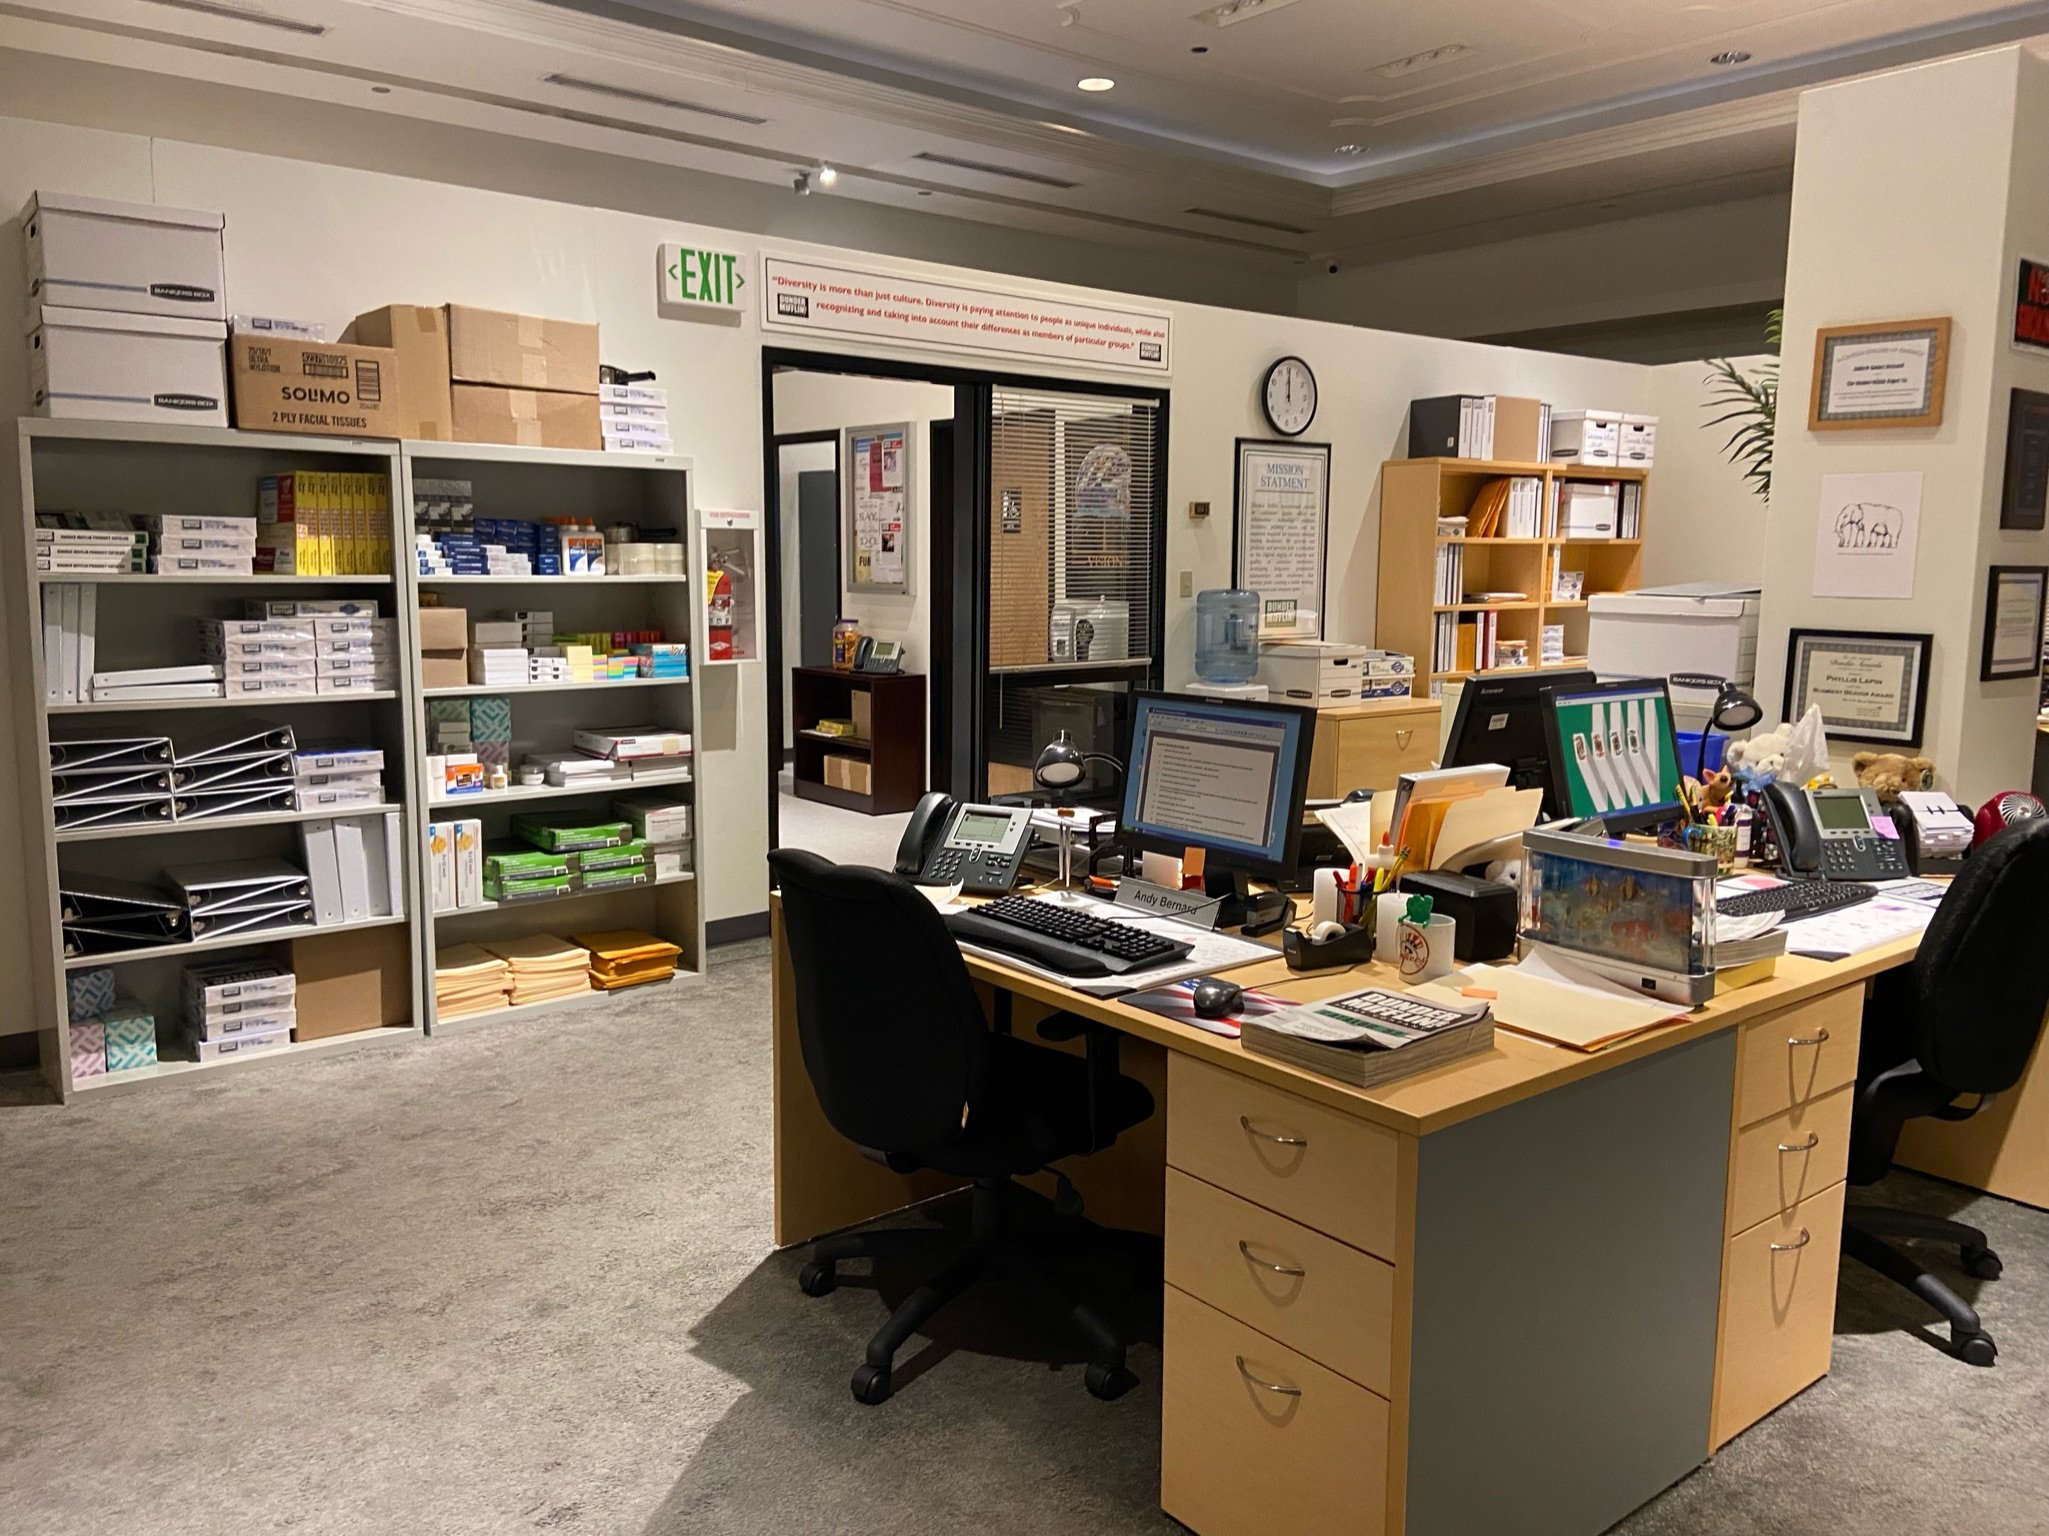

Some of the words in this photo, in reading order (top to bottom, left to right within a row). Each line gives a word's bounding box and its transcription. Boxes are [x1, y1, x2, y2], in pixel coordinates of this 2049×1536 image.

[680, 248, 737, 304] EXIT
[816, 301, 865, 316] recognizing
[867, 306, 882, 317] and
[884, 309, 909, 323] taking
[911, 314, 927, 323] into
[929, 316, 959, 327] account
[961, 320, 979, 330] their
[981, 323, 1021, 335] differences
[1022, 329, 1030, 337] as
[1031, 330, 1064, 341] members
[1074, 335, 1107, 346] particular
[819, 283, 826, 292] is
[829, 285, 851, 295] more
[854, 287, 873, 298] than
[875, 290, 890, 301] just
[893, 293, 923, 305] culture.
[925, 298, 960, 311] Diversity
[962, 303, 968, 311] is
[970, 305, 994, 317] paying
[996, 308, 1029, 320] attention
[1031, 313, 1038, 321] to
[1040, 315, 1063, 325] people
[1074, 320, 1096, 331] unique
[1098, 322, 1134, 335] individuals,
[1135, 328, 1151, 338] while
[1153, 330, 1165, 339] also
[272, 411, 278, 423] 2
[281, 413, 297, 423] PLY
[300, 414, 329, 426] FACIAL
[331, 416, 368, 428] TISSUES
[1267, 463, 1304, 476] MISSION
[1260, 476, 1309, 489] STATMENT
[1267, 601, 1295, 612] DUNDER
[1826, 675, 1858, 683] PHYLLIS
[1859, 677, 1883, 685] LAPIN
[1134, 890, 1158, 907] Andy
[1159, 896, 1198, 915] Bernard
[1341, 998, 1444, 1028] MIFFLIN
[1360, 993, 1462, 1021] DUNDER
